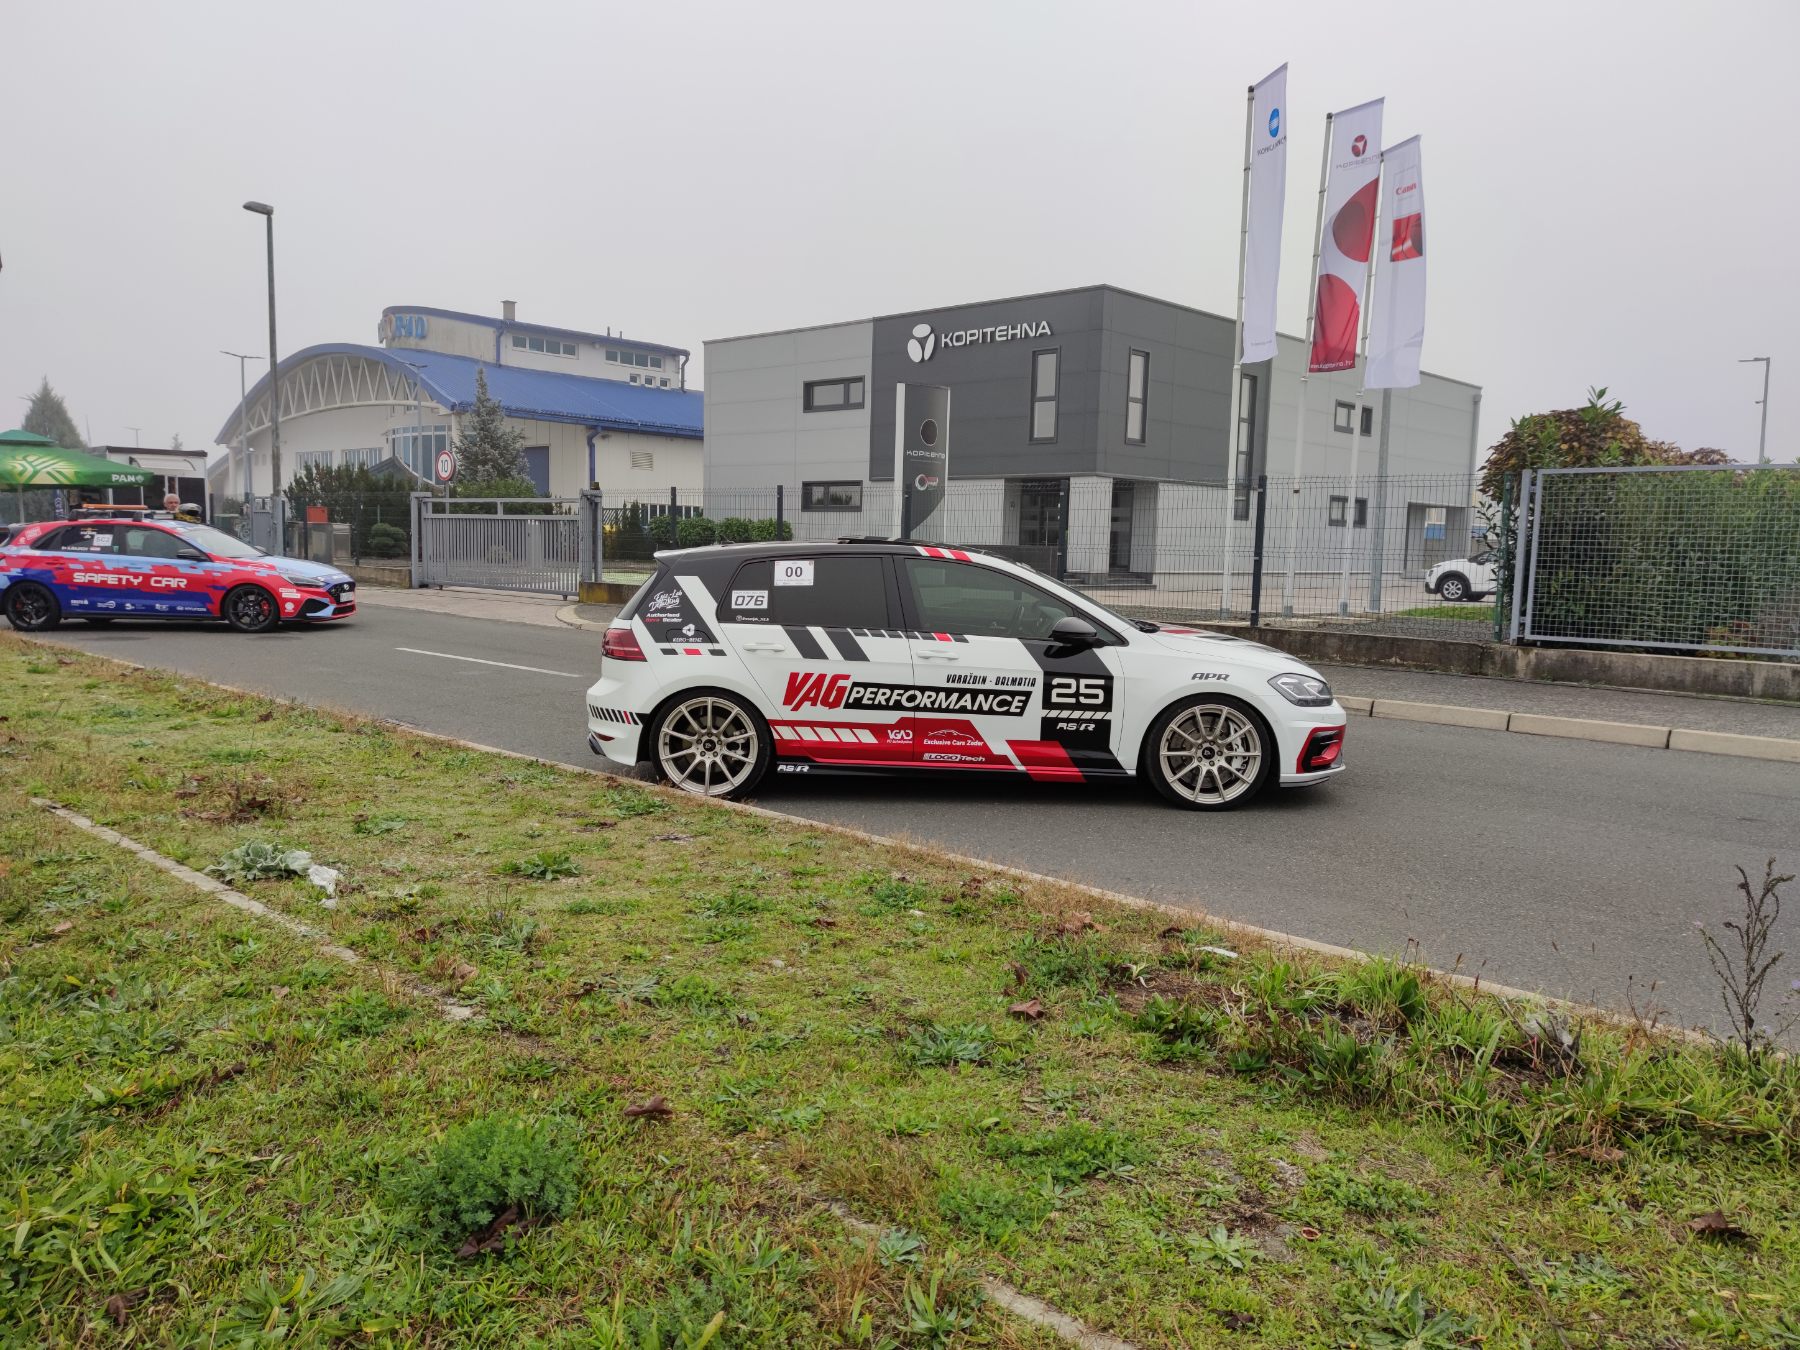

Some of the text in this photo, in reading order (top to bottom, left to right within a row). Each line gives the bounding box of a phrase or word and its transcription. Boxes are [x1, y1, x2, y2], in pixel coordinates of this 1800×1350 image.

[941, 320, 1052, 348] KOPITEHNA
[441, 459, 449, 473] 10
[111, 473, 136, 483] PAN
[785, 566, 803, 578] 00
[73, 572, 188, 588] SAFETY CAR
[734, 595, 765, 606] 076
[946, 673, 987, 685] VARAŽDIN
[994, 675, 1037, 688] DALMATIA
[1191, 672, 1230, 681] APR
[782, 672, 1027, 713] VAG PERFORMANCE
[1051, 677, 1105, 705] 25
[923, 738, 951, 746] Exclusive
